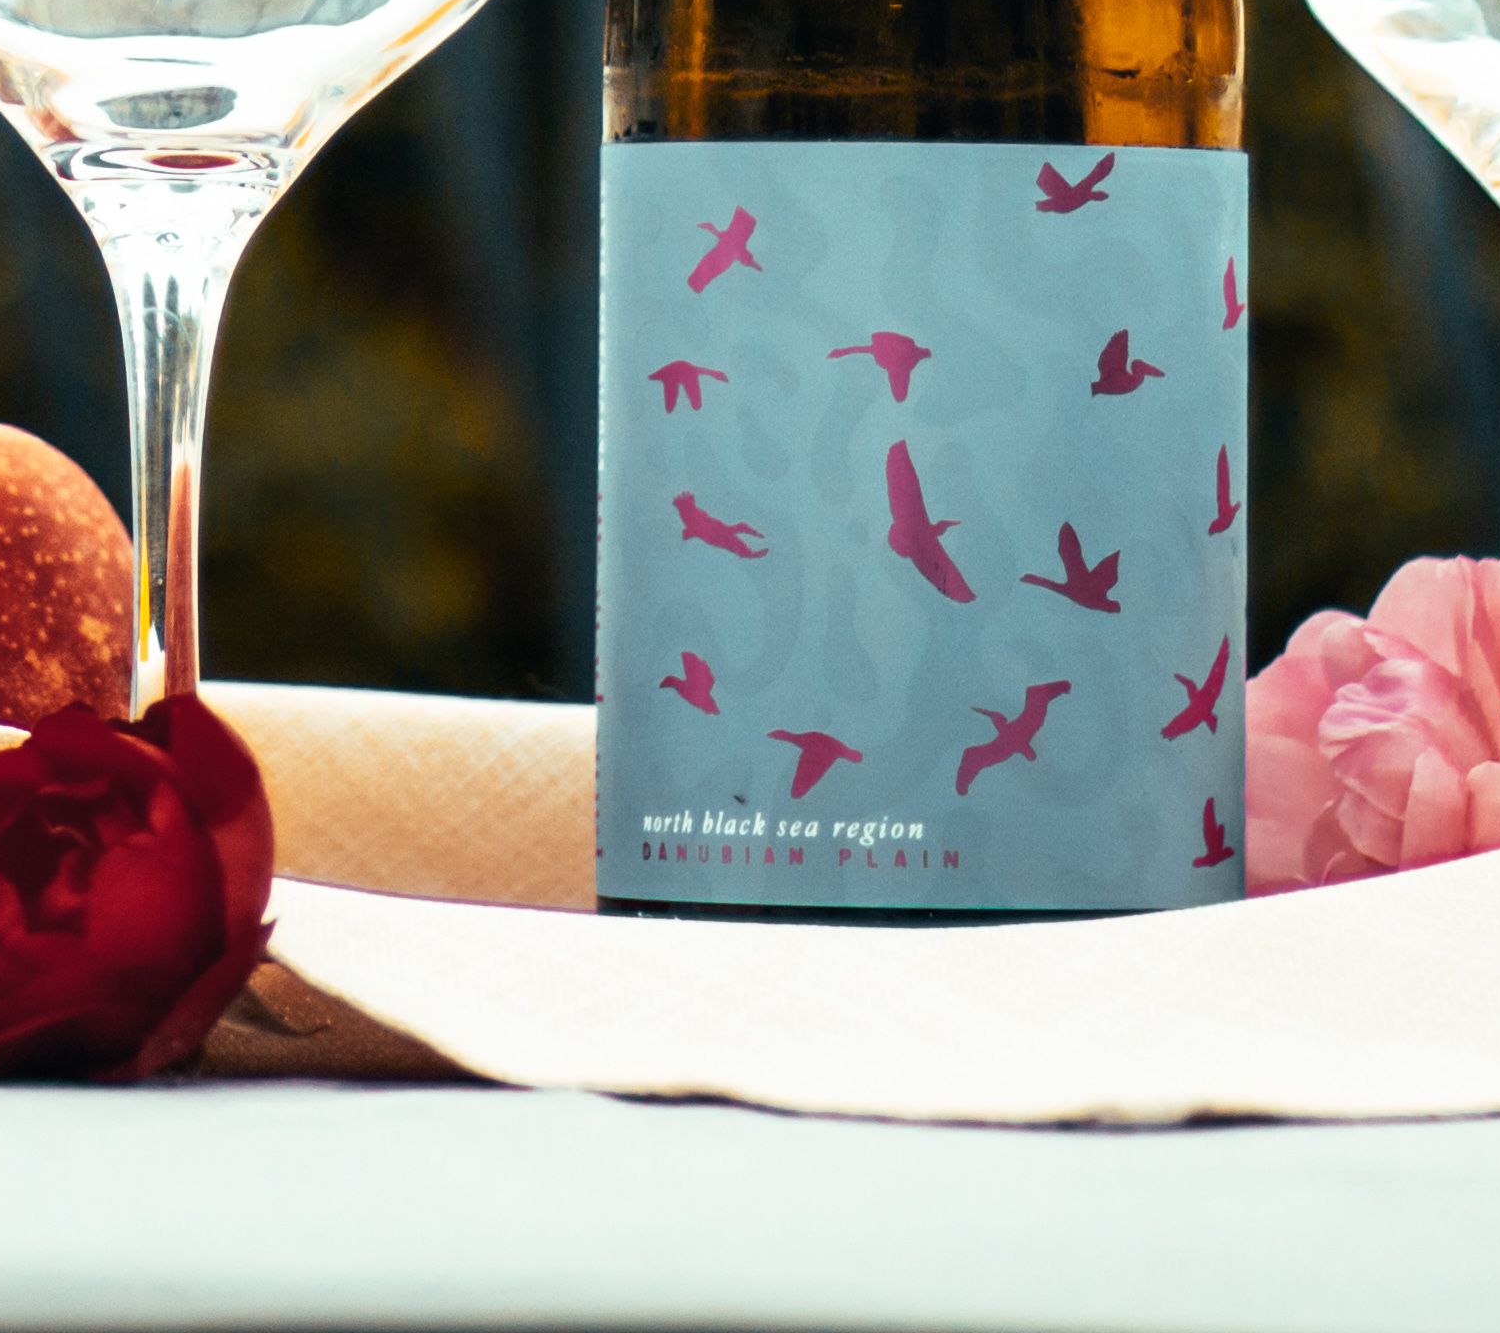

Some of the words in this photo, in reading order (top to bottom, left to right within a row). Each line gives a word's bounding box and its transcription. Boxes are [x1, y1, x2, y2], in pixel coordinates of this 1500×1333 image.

[642, 810, 693, 834] north
[702, 810, 766, 836] black
[776, 819, 819, 838] sea
[832, 815, 925, 846] region
[642, 841, 804, 865] DANUBIAN
[838, 848, 960, 869] PLAIN
